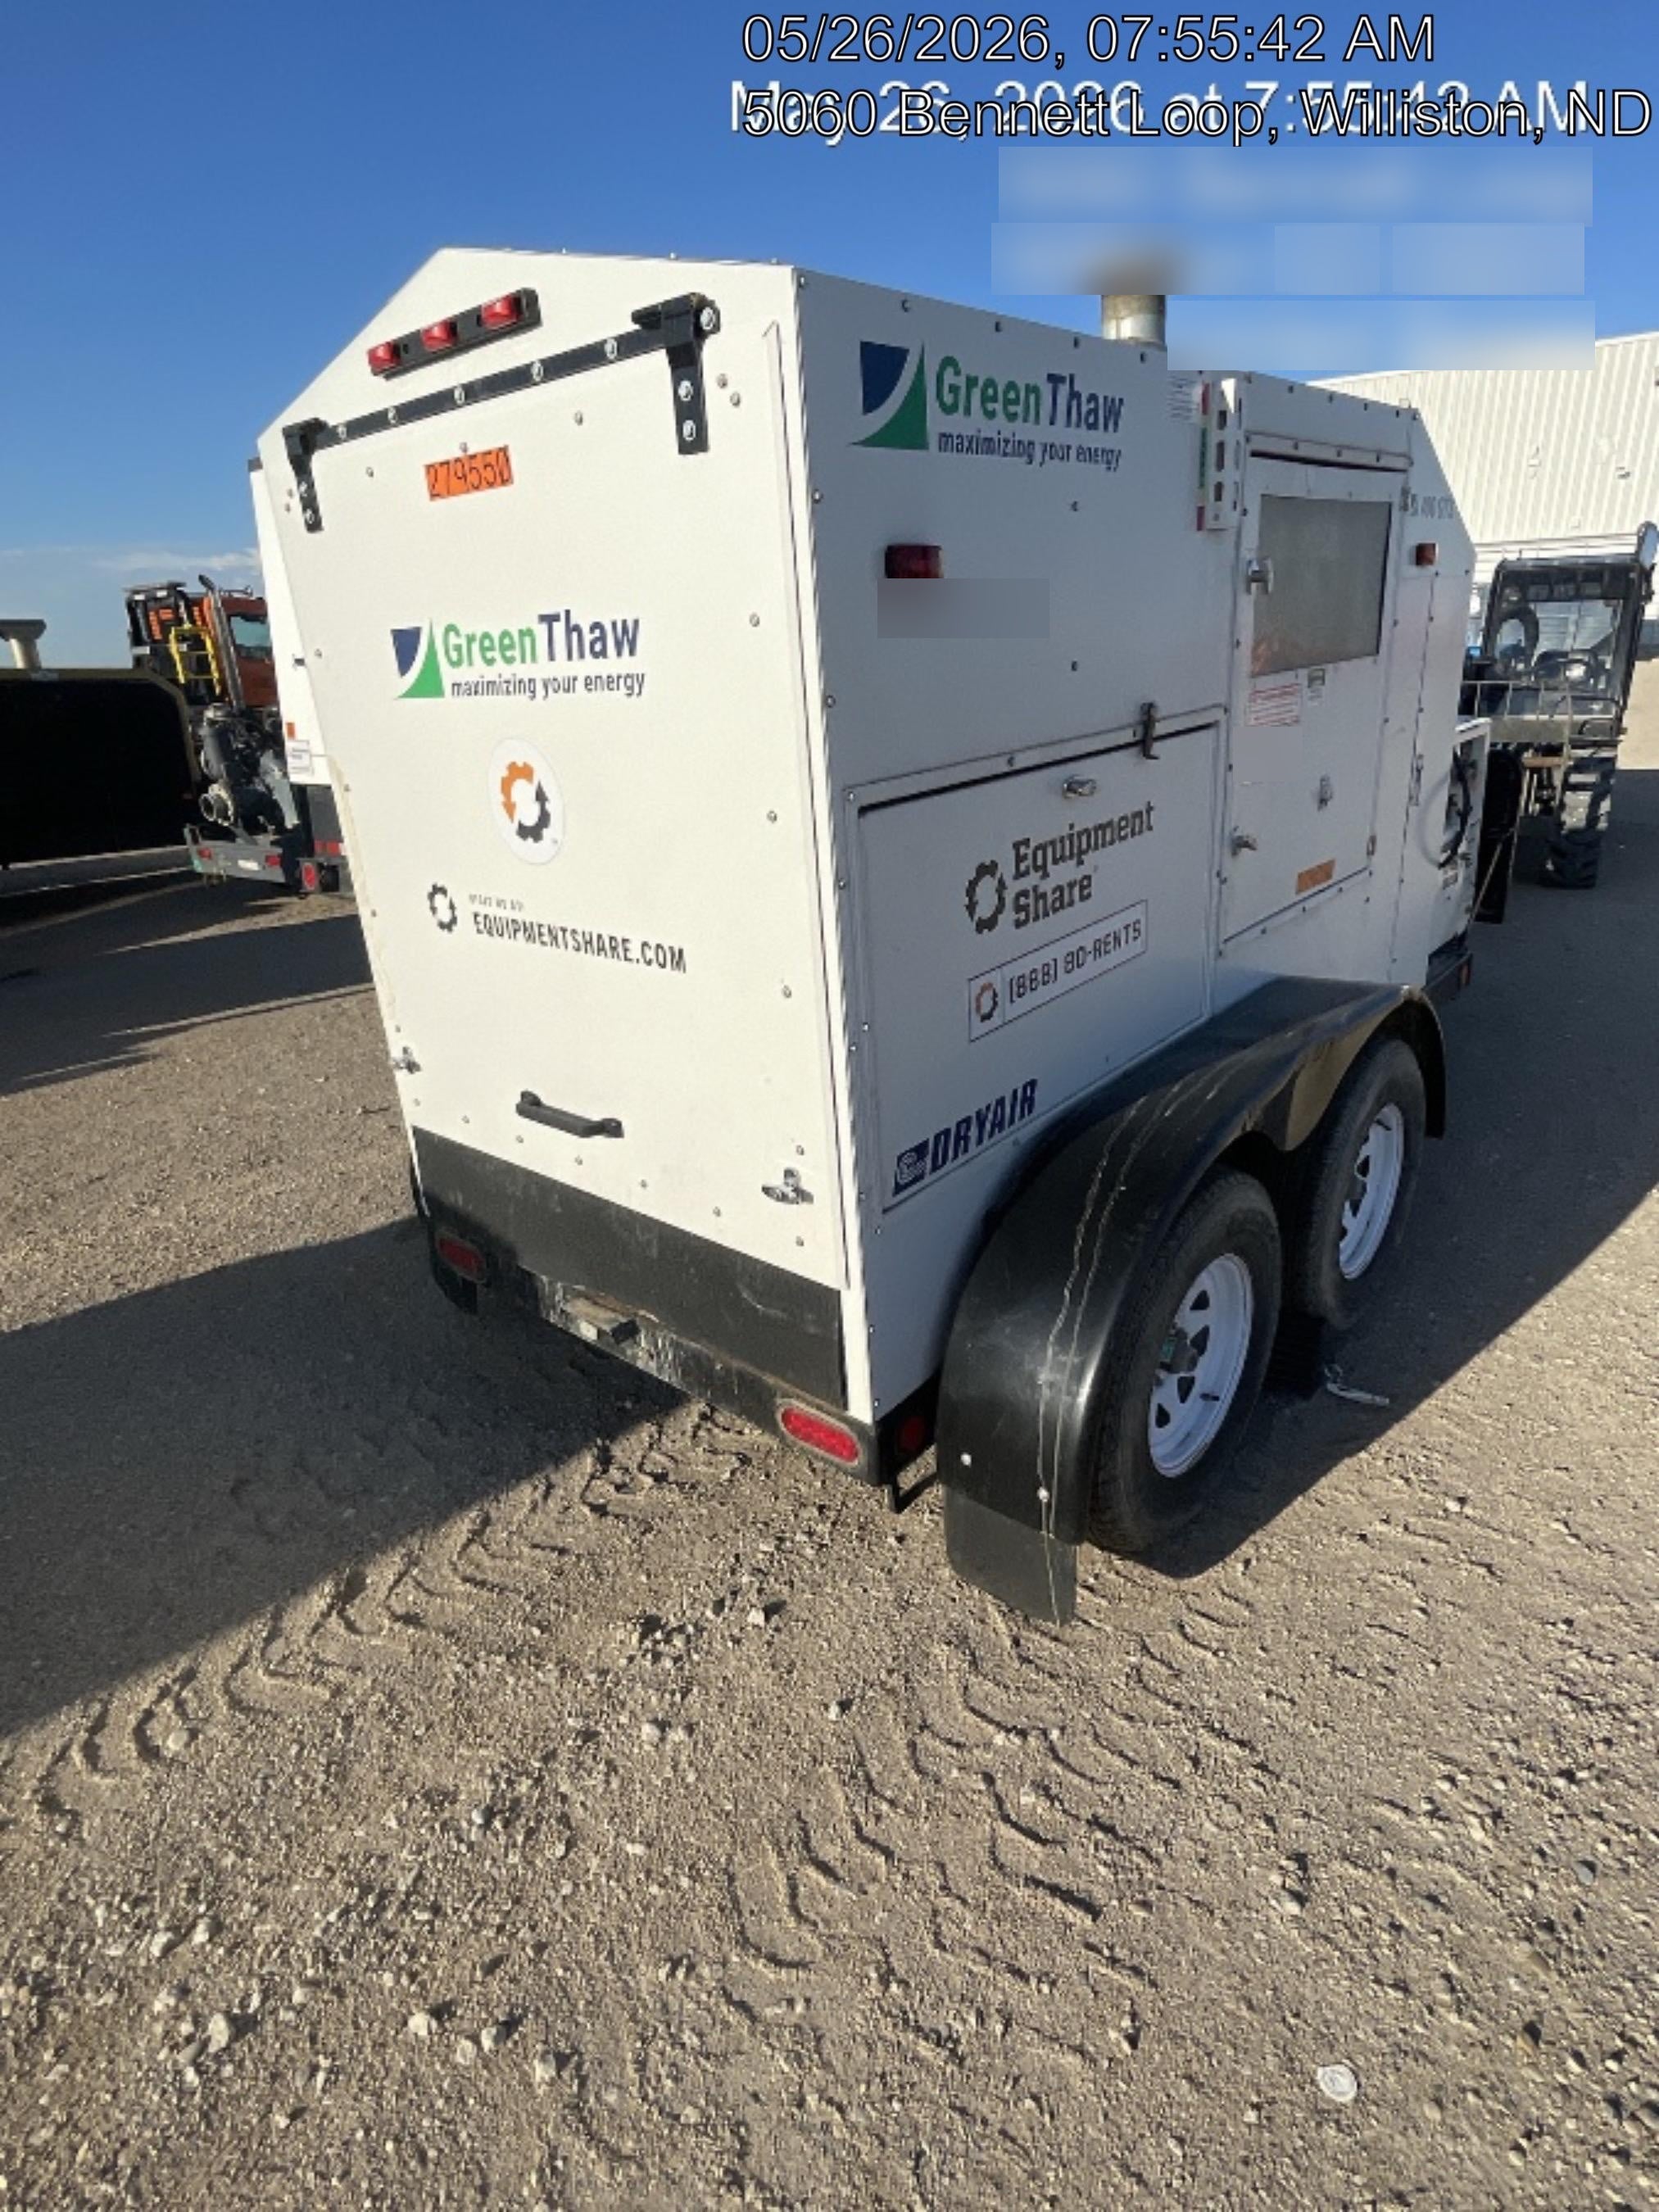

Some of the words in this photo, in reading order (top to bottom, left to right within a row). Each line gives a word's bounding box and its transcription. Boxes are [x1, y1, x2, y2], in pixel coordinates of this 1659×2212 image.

[936, 355, 1125, 434] GreenThaw
[424, 446, 512, 500] 279550
[938, 428, 1036, 465] maximizing
[1039, 442, 1072, 468] your
[1076, 444, 1122, 473] energy
[442, 609, 640, 669] GreenThaw
[451, 673, 537, 700] maximizing
[541, 673, 578, 700] your
[583, 672, 646, 697] energy
[1012, 800, 1155, 881] Equipment
[1013, 873, 1093, 931] Share
[473, 911, 687, 974] EQUIPMENTSHARE.COM
[928, 1077, 1039, 1176] DRYAIR
